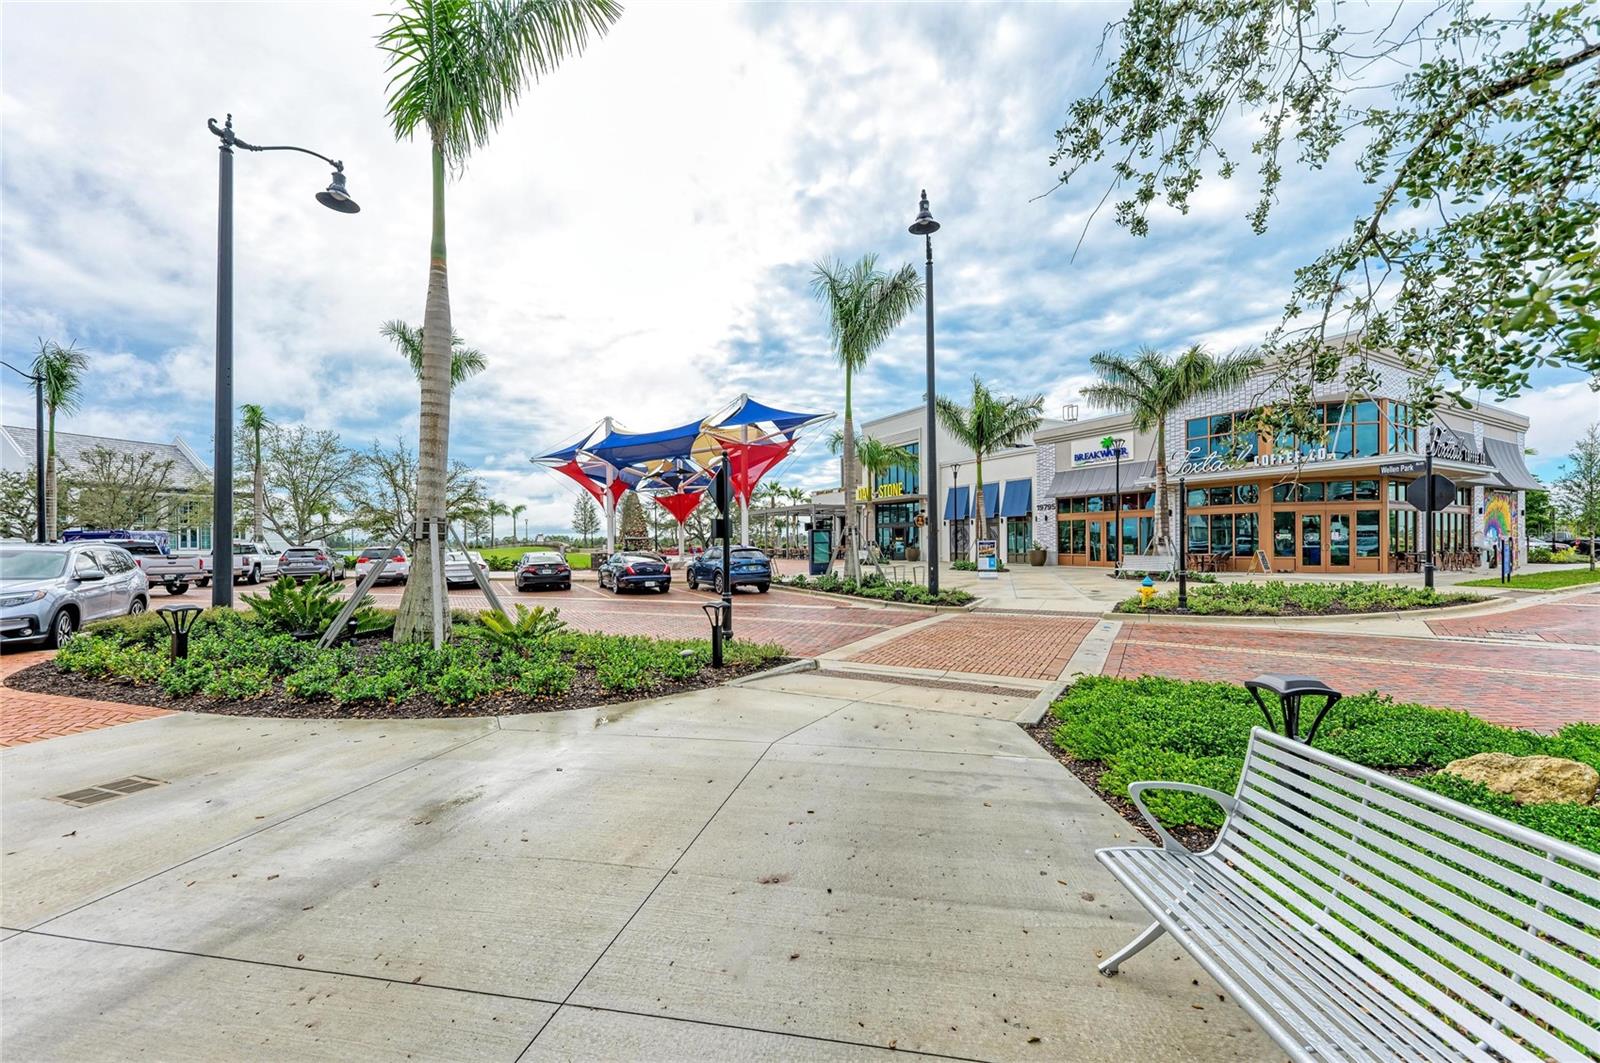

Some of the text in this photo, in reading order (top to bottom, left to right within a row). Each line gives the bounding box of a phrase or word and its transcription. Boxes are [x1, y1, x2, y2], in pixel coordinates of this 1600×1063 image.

[1073, 447, 1128, 461] BREAKWATR
[1254, 450, 1301, 466] COFFEE
[1380, 466, 1400, 474] Wellen
[1400, 464, 1414, 472] Park
[879, 482, 904, 498] STONE
